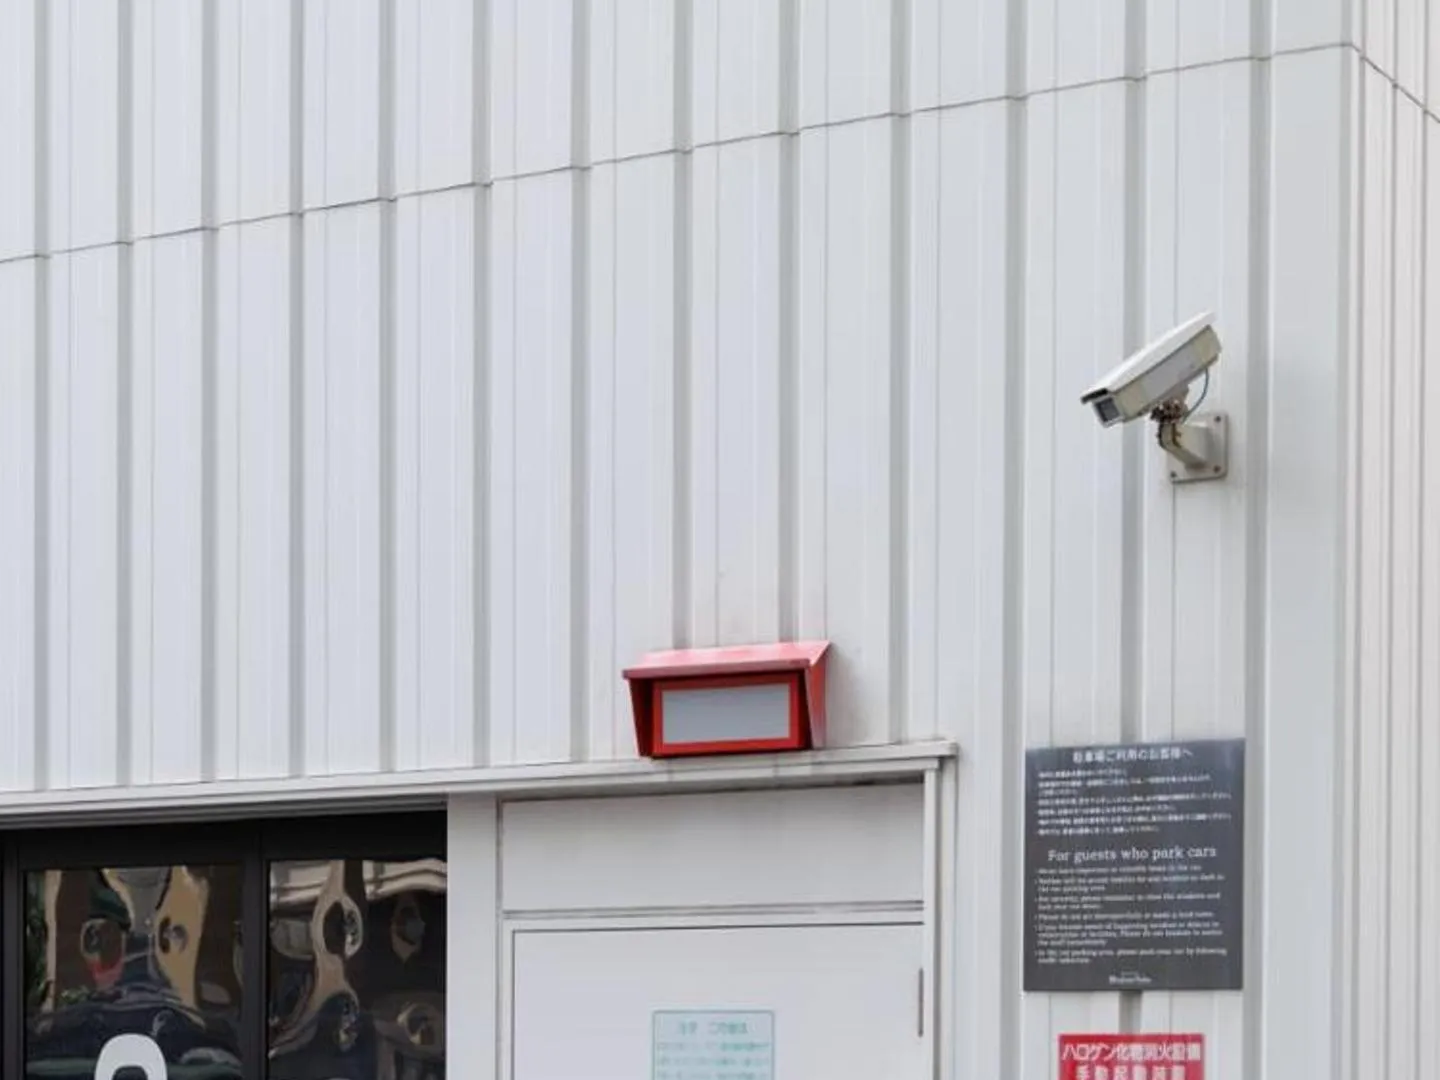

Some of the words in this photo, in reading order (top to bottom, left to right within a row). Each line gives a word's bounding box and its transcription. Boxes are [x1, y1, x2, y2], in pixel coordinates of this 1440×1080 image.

[1048, 850, 1069, 861] For
[1074, 849, 1117, 864] guests
[1121, 847, 1148, 860] who
[1152, 846, 1184, 860] park
[1187, 847, 1217, 859] cars
